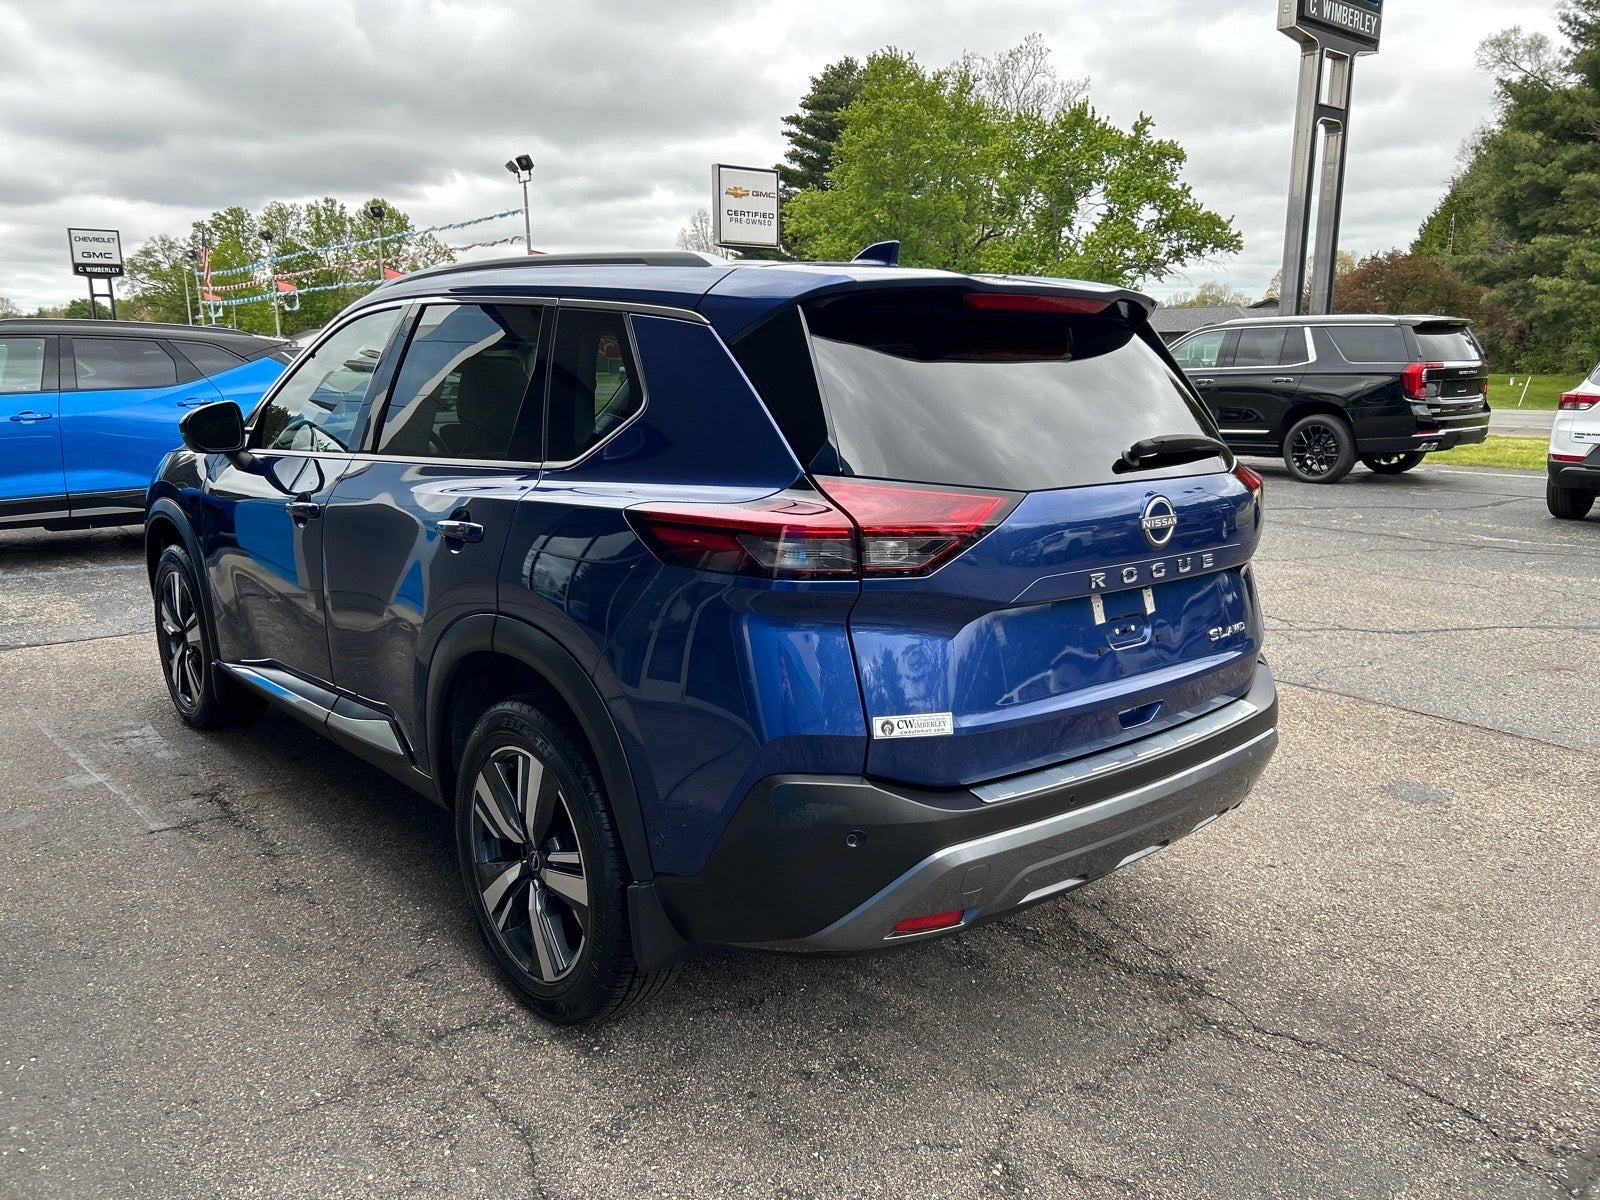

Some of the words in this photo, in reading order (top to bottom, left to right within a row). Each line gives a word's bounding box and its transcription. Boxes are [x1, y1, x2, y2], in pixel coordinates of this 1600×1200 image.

[1323, 0, 1378, 35] WIMBERLEY
[752, 190, 776, 199] GMC
[726, 209, 775, 220] CERTIFIED
[729, 217, 772, 227] PRE-OWNED
[81, 251, 113, 259] GMC
[85, 266, 120, 274] WIMBERLEY
[1142, 516, 1177, 529] NISSAN
[1090, 553, 1214, 589] ROGUE
